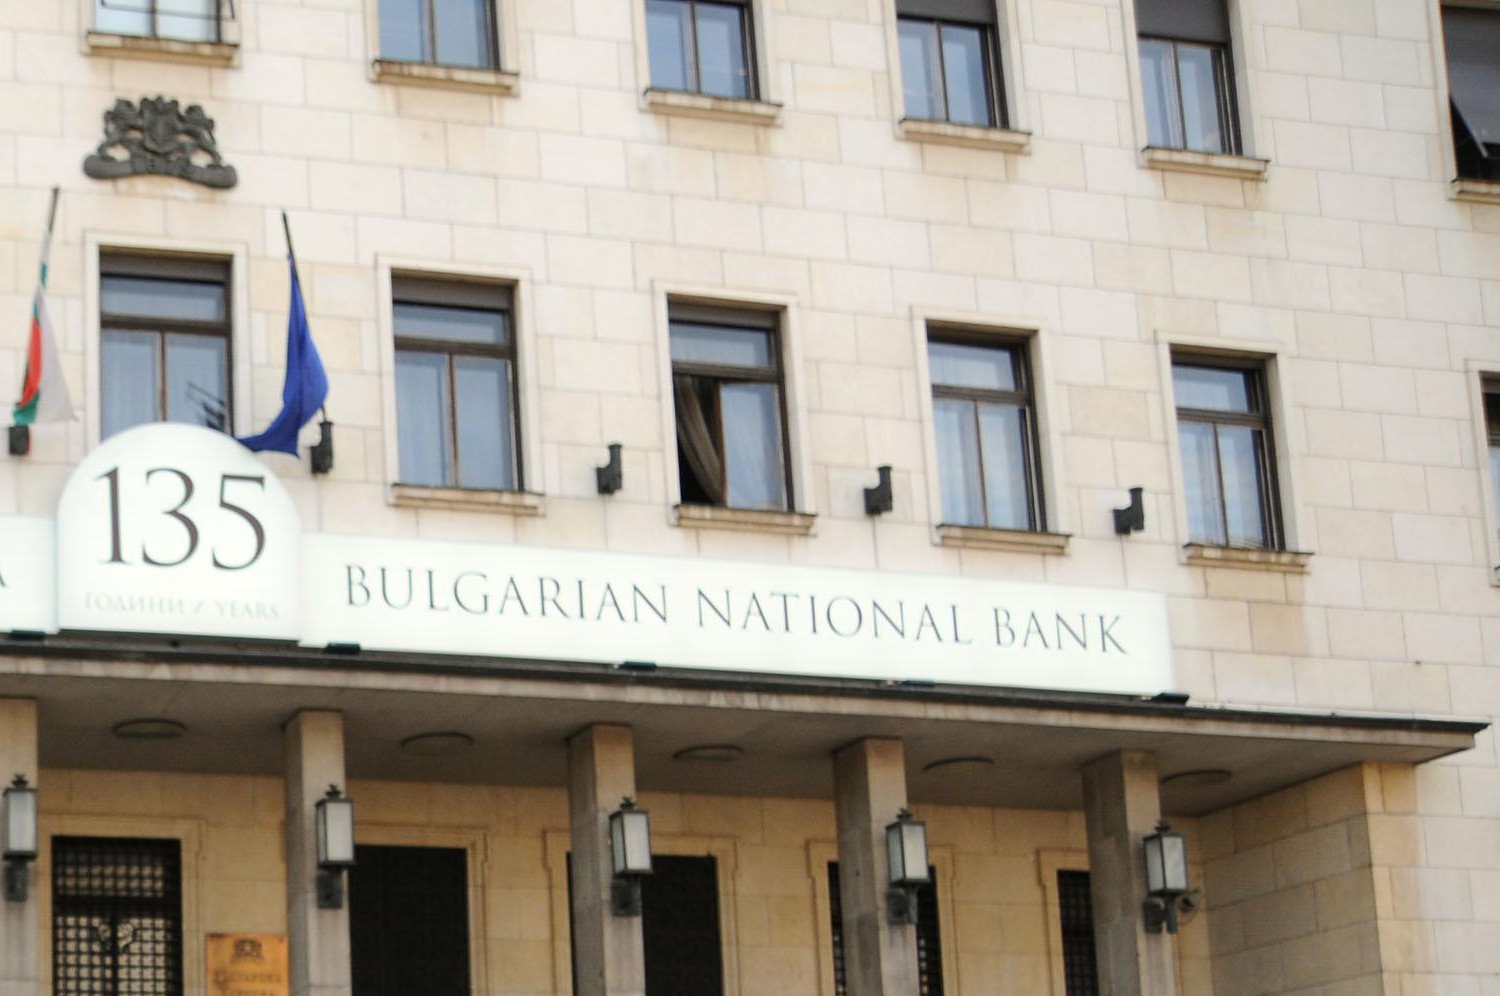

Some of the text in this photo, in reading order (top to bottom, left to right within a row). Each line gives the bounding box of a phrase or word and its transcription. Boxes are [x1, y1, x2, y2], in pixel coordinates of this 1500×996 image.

[93, 466, 266, 570] 135
[213, 599, 280, 620] YEARS
[344, 564, 1128, 656] BULGARIAN NATIONAL BANK
